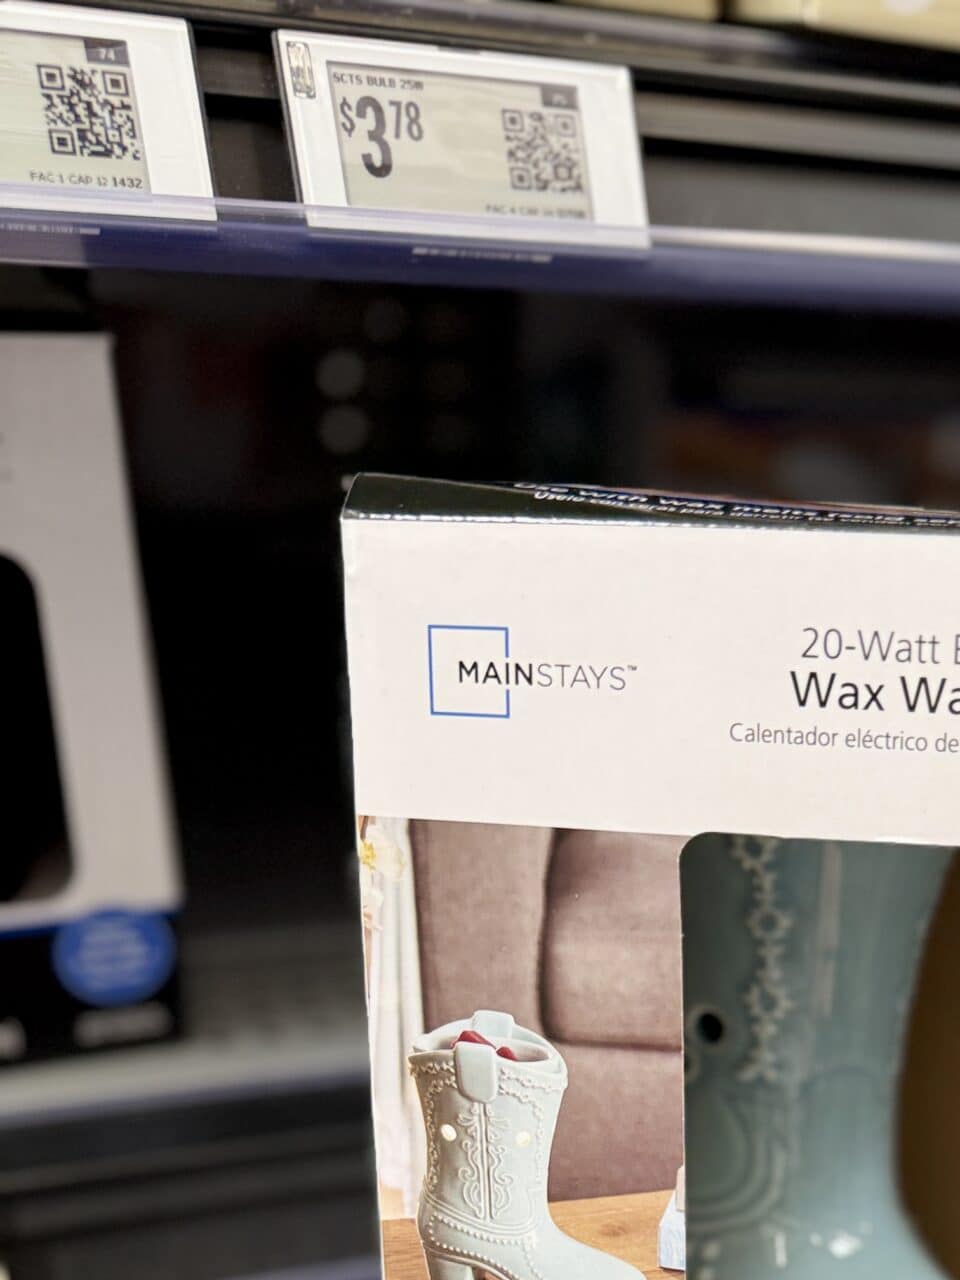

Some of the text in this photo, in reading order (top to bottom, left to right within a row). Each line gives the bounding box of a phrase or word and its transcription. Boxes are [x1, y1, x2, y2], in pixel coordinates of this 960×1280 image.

[112, 177, 143, 189] 1432
[801, 626, 940, 665] 20-Watt
[790, 670, 885, 711] Wax
[729, 722, 839, 747] Calentador
[845, 728, 928, 752] eléctrico
[935, 732, 959, 754] de
